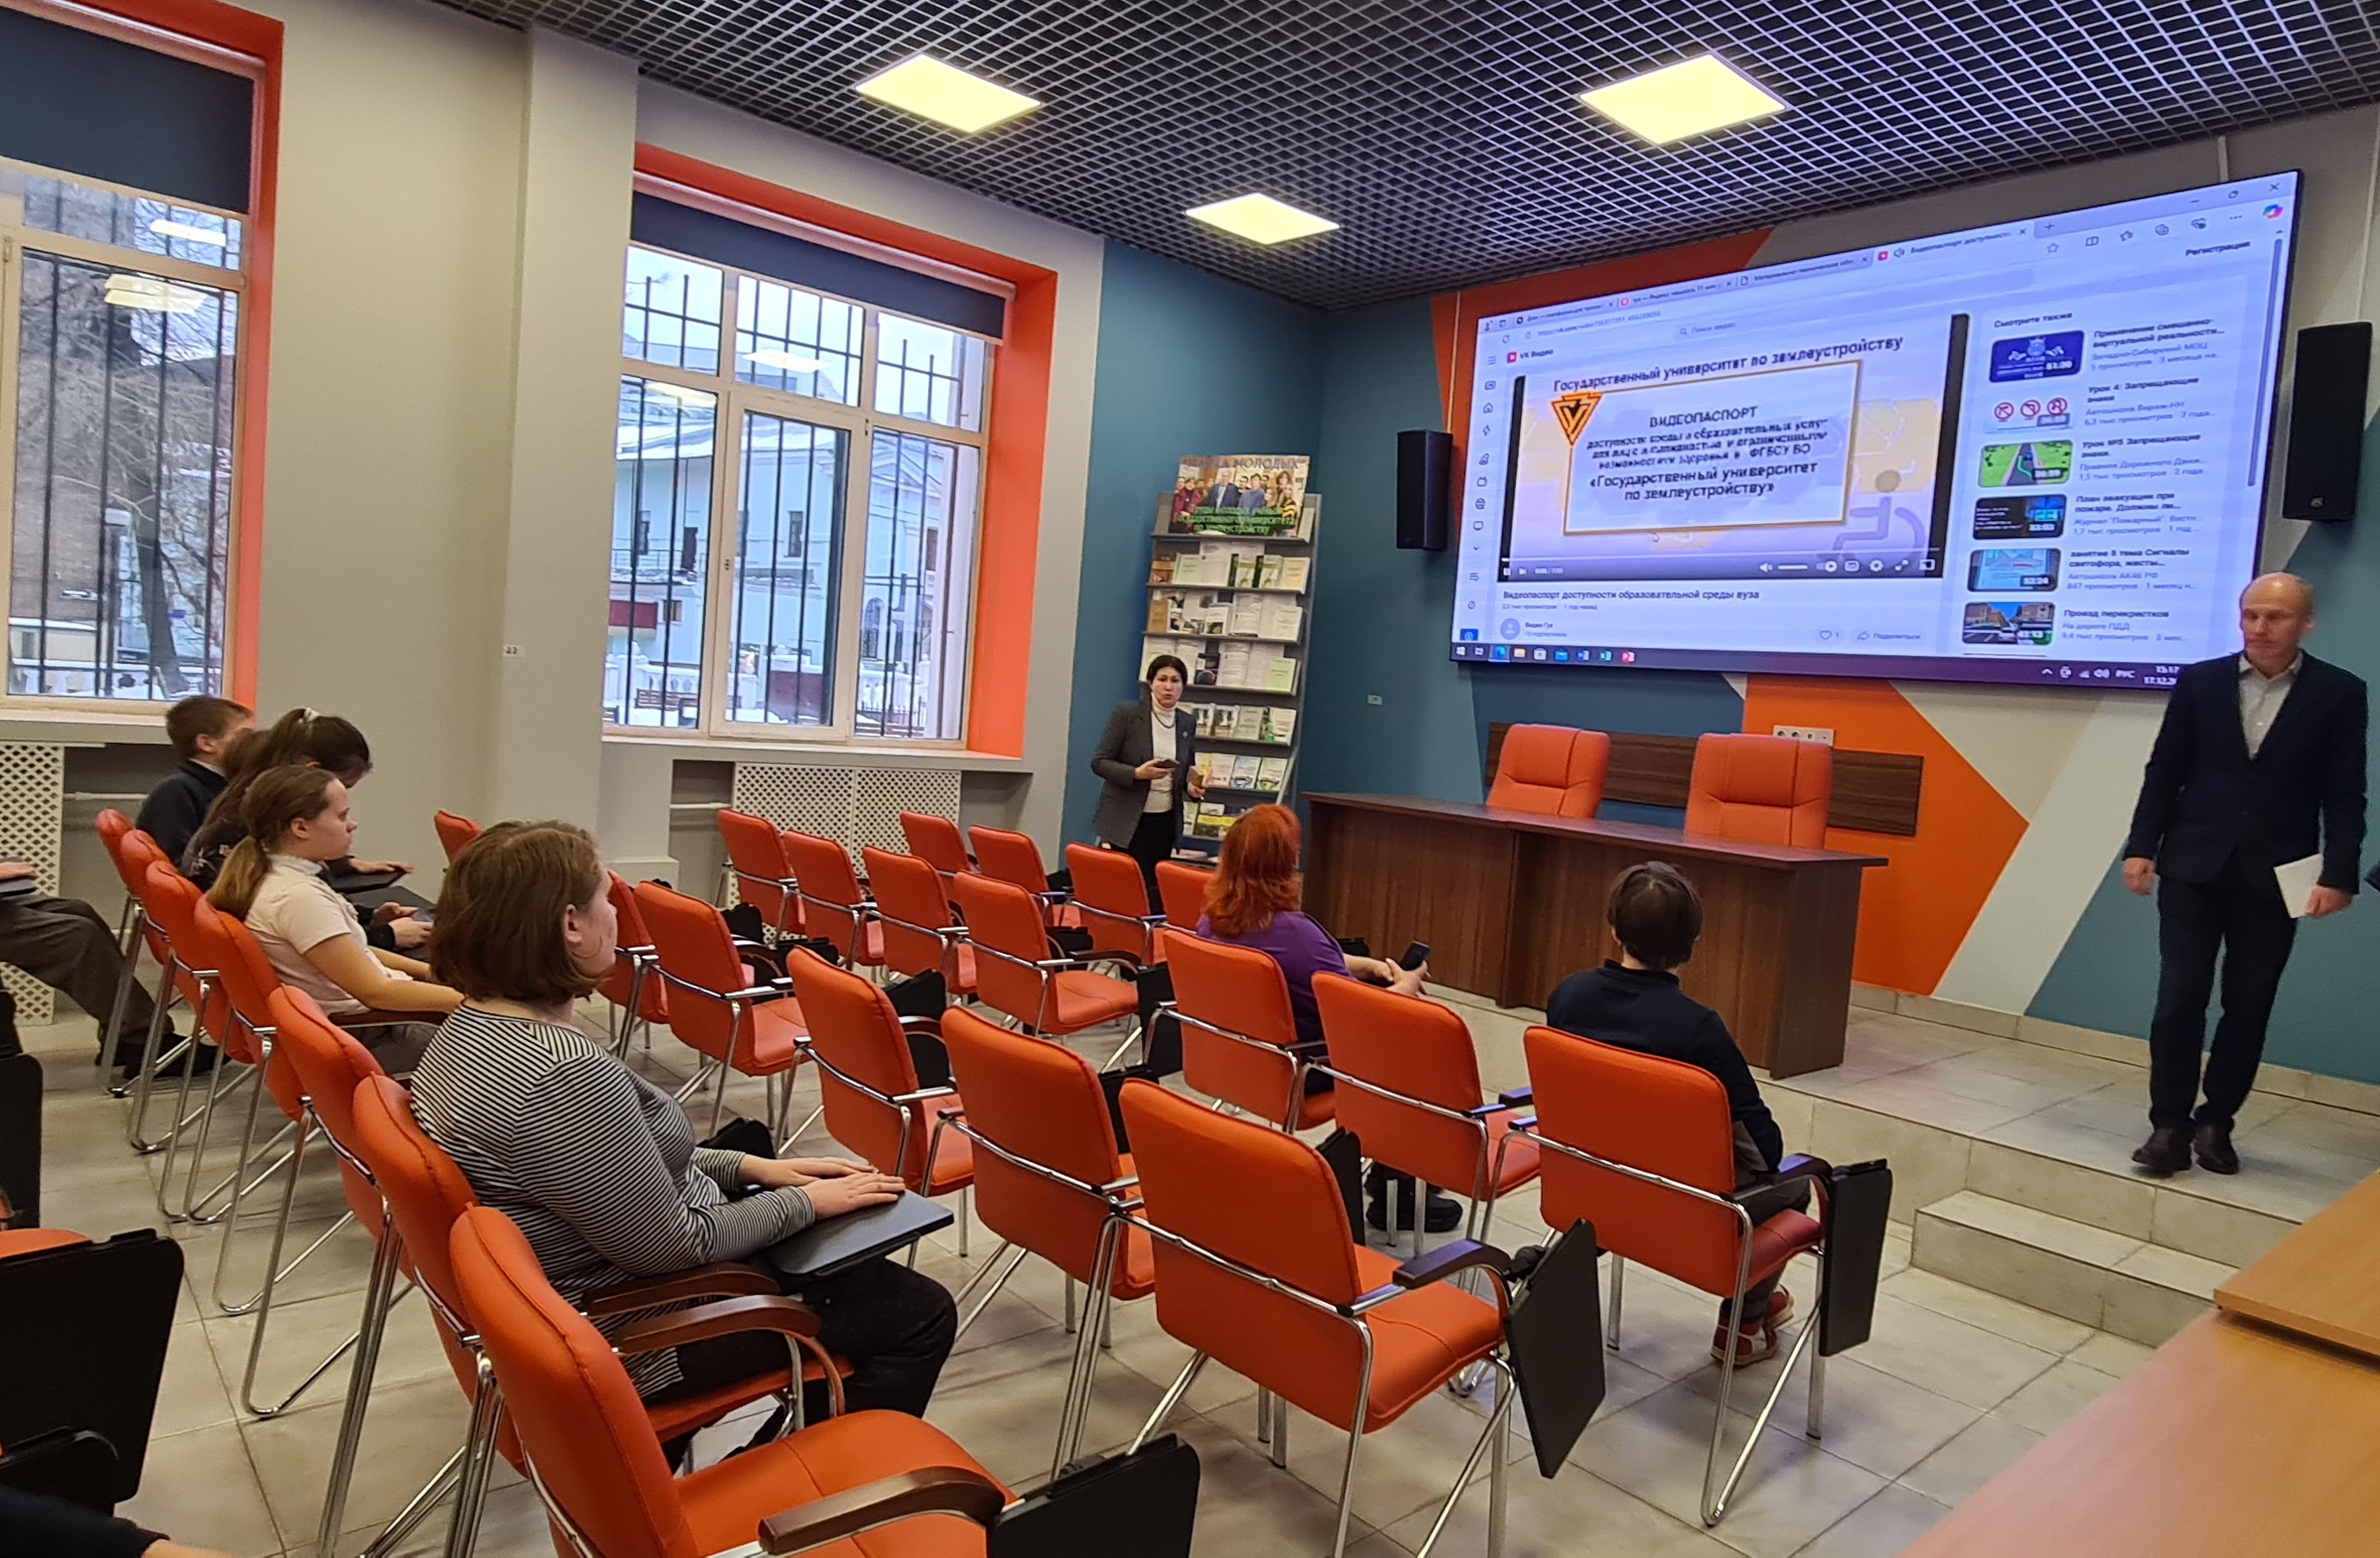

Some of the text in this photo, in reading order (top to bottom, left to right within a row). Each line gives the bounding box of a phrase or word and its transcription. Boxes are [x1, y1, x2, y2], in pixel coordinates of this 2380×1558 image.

[2185, 241, 2250, 256] Регистрация
[1993, 311, 2074, 329] Смотрите также
[2093, 334, 2155, 349] виртуальной
[1519, 349, 1555, 360] VK Видео
[1553, 337, 1904, 392] Государственный университет по землеустройству
[2088, 385, 2111, 394] Урок
[2124, 377, 2200, 390] Запрещающие
[2087, 395, 2115, 404] знаки
[1649, 406, 1758, 428] ВИДЕОПАСПОРТ
[2082, 440, 2105, 450] Урок
[2126, 434, 2202, 446] Запрещающие
[1590, 461, 1819, 489] «Государственный университет
[1624, 481, 1775, 502] по землеустройству»
[2076, 495, 2101, 503] План
[2145, 548, 2190, 557] Сигналы
[1503, 589, 1760, 601] Видеопаспорт доступности образовательной среды вуза
[2063, 609, 2170, 619] Проезд перекрестков
